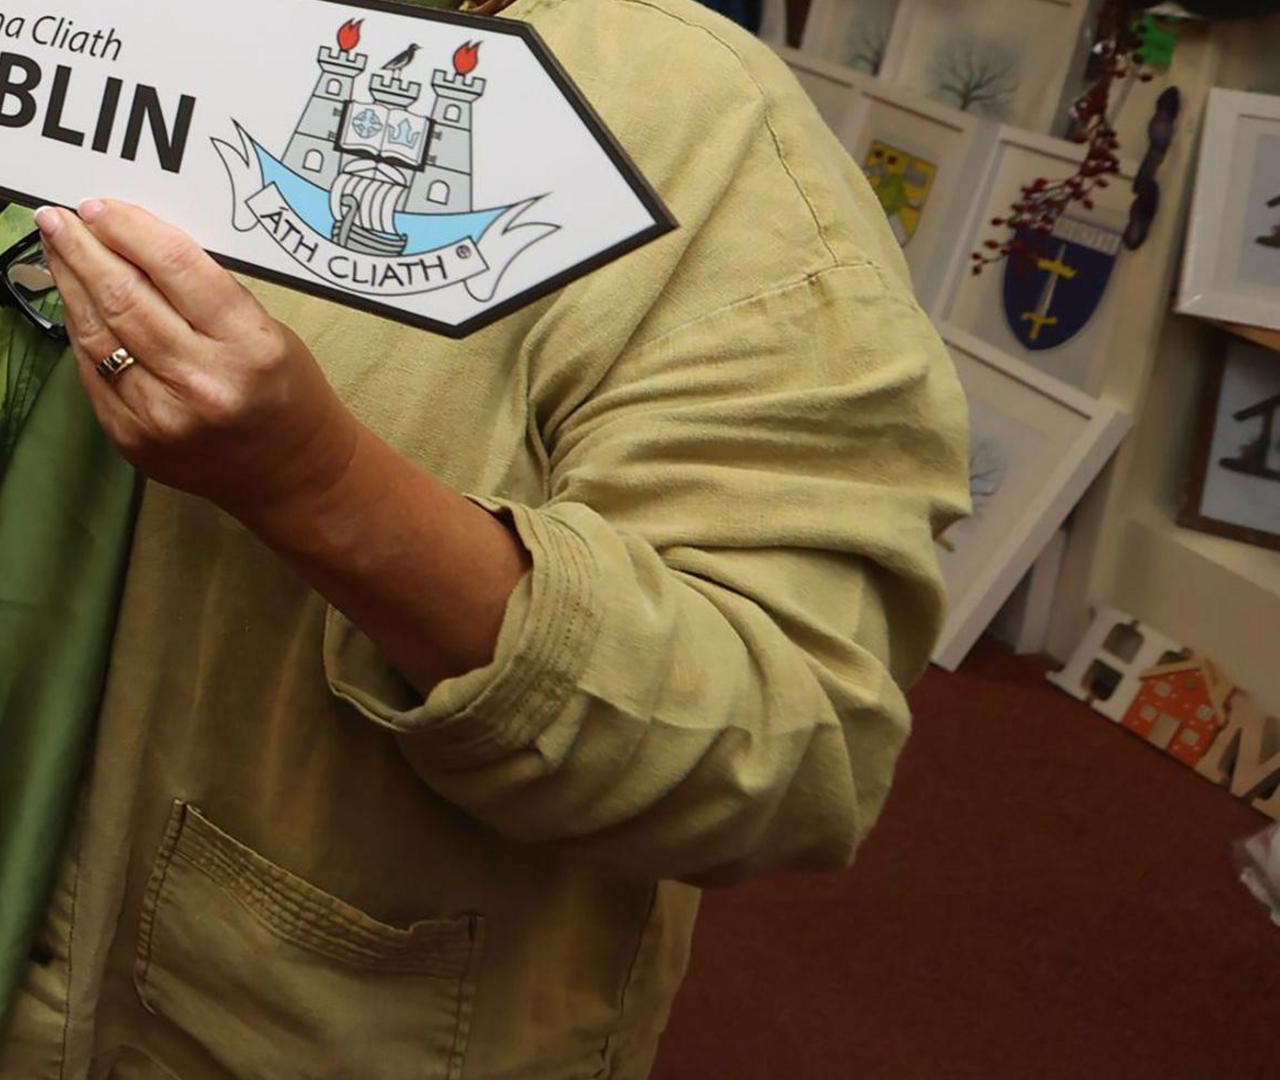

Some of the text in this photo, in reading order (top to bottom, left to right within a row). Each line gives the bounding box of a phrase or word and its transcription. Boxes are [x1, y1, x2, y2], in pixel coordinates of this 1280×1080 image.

[32, 15, 122, 61] Cliath
[261, 206, 318, 262] ÁTH
[328, 255, 447, 287] CLIATH
